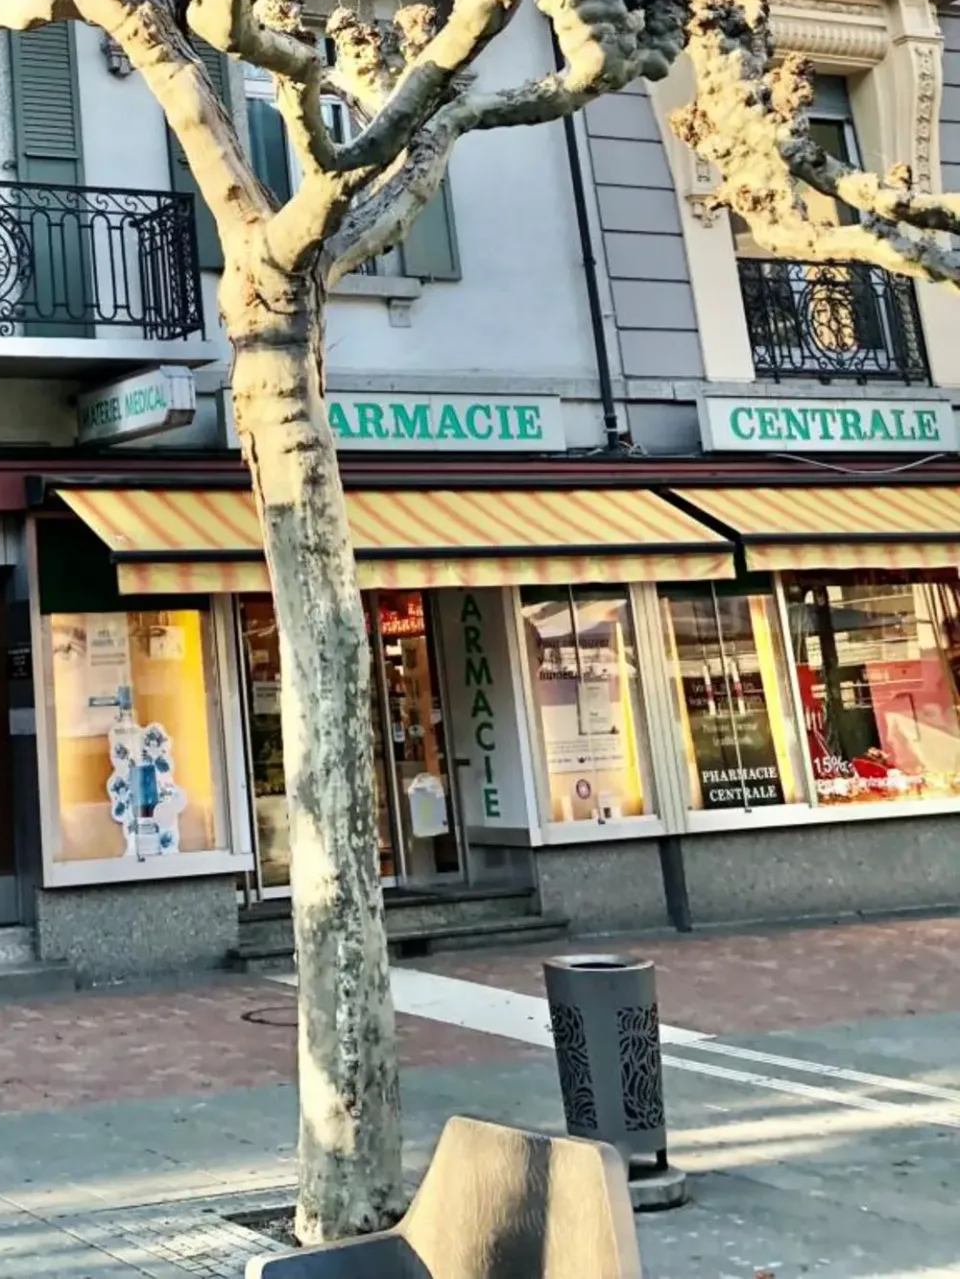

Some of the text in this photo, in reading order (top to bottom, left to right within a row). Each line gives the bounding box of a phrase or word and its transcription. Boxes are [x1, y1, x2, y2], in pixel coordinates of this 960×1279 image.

[328, 402, 543, 440] ARMACIE
[729, 407, 940, 441] CENTRALE
[461, 593, 501, 818] ARMACIE
[702, 766, 778, 783] PHARMACIE
[709, 785, 777, 802] CENTRALE
